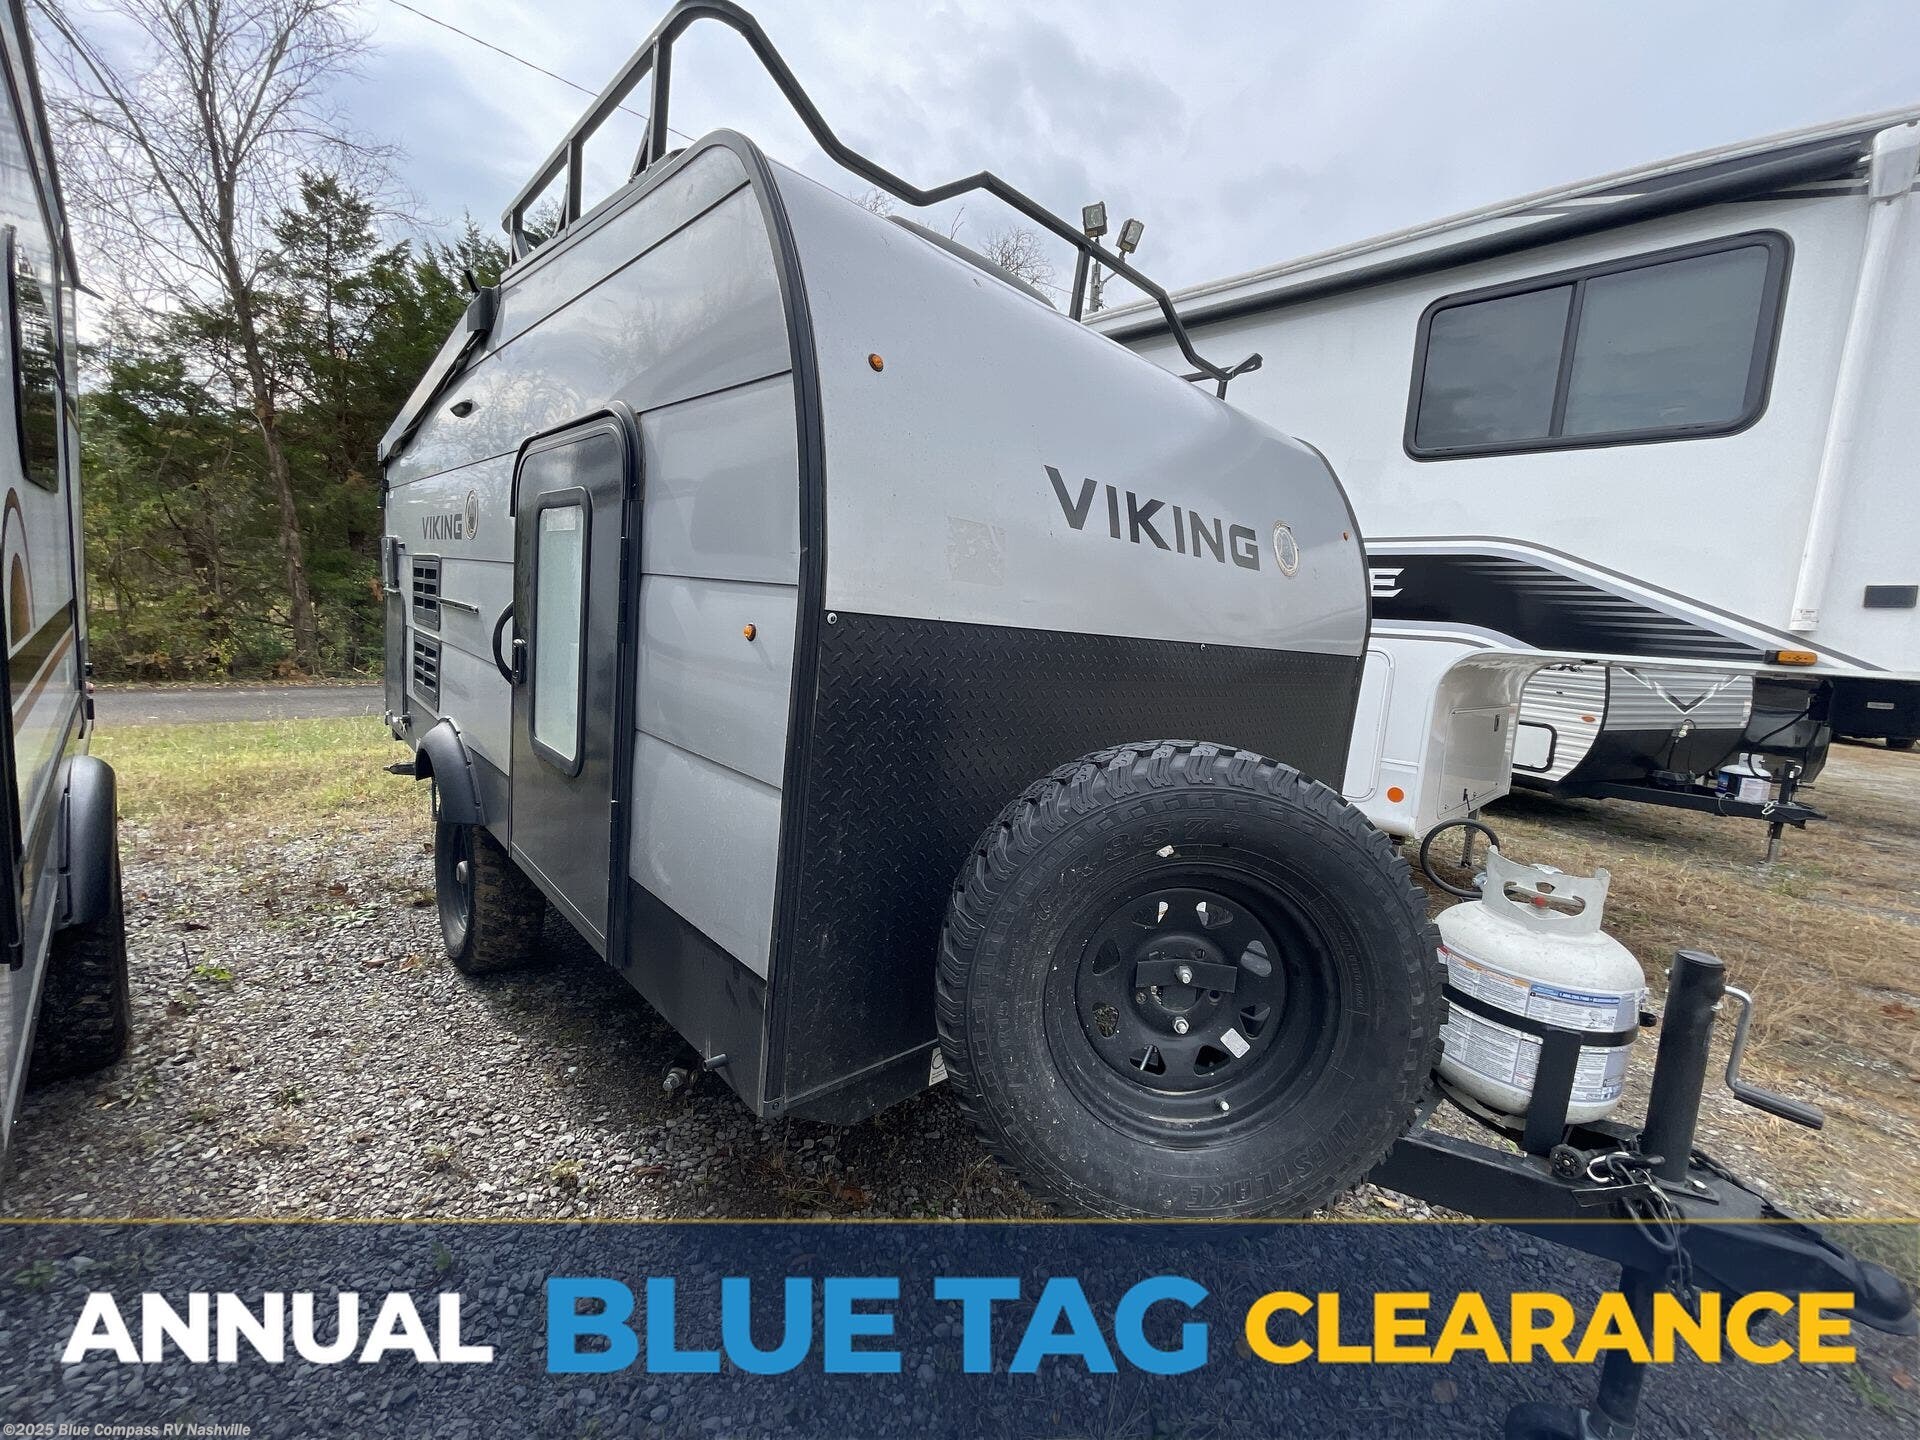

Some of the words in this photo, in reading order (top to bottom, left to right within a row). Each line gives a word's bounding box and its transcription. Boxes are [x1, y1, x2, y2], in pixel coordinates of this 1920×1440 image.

[422, 513, 463, 540] VIKING
[1044, 465, 1260, 571] VIKING
[1185, 1110, 1362, 1210] WESTLAKE
